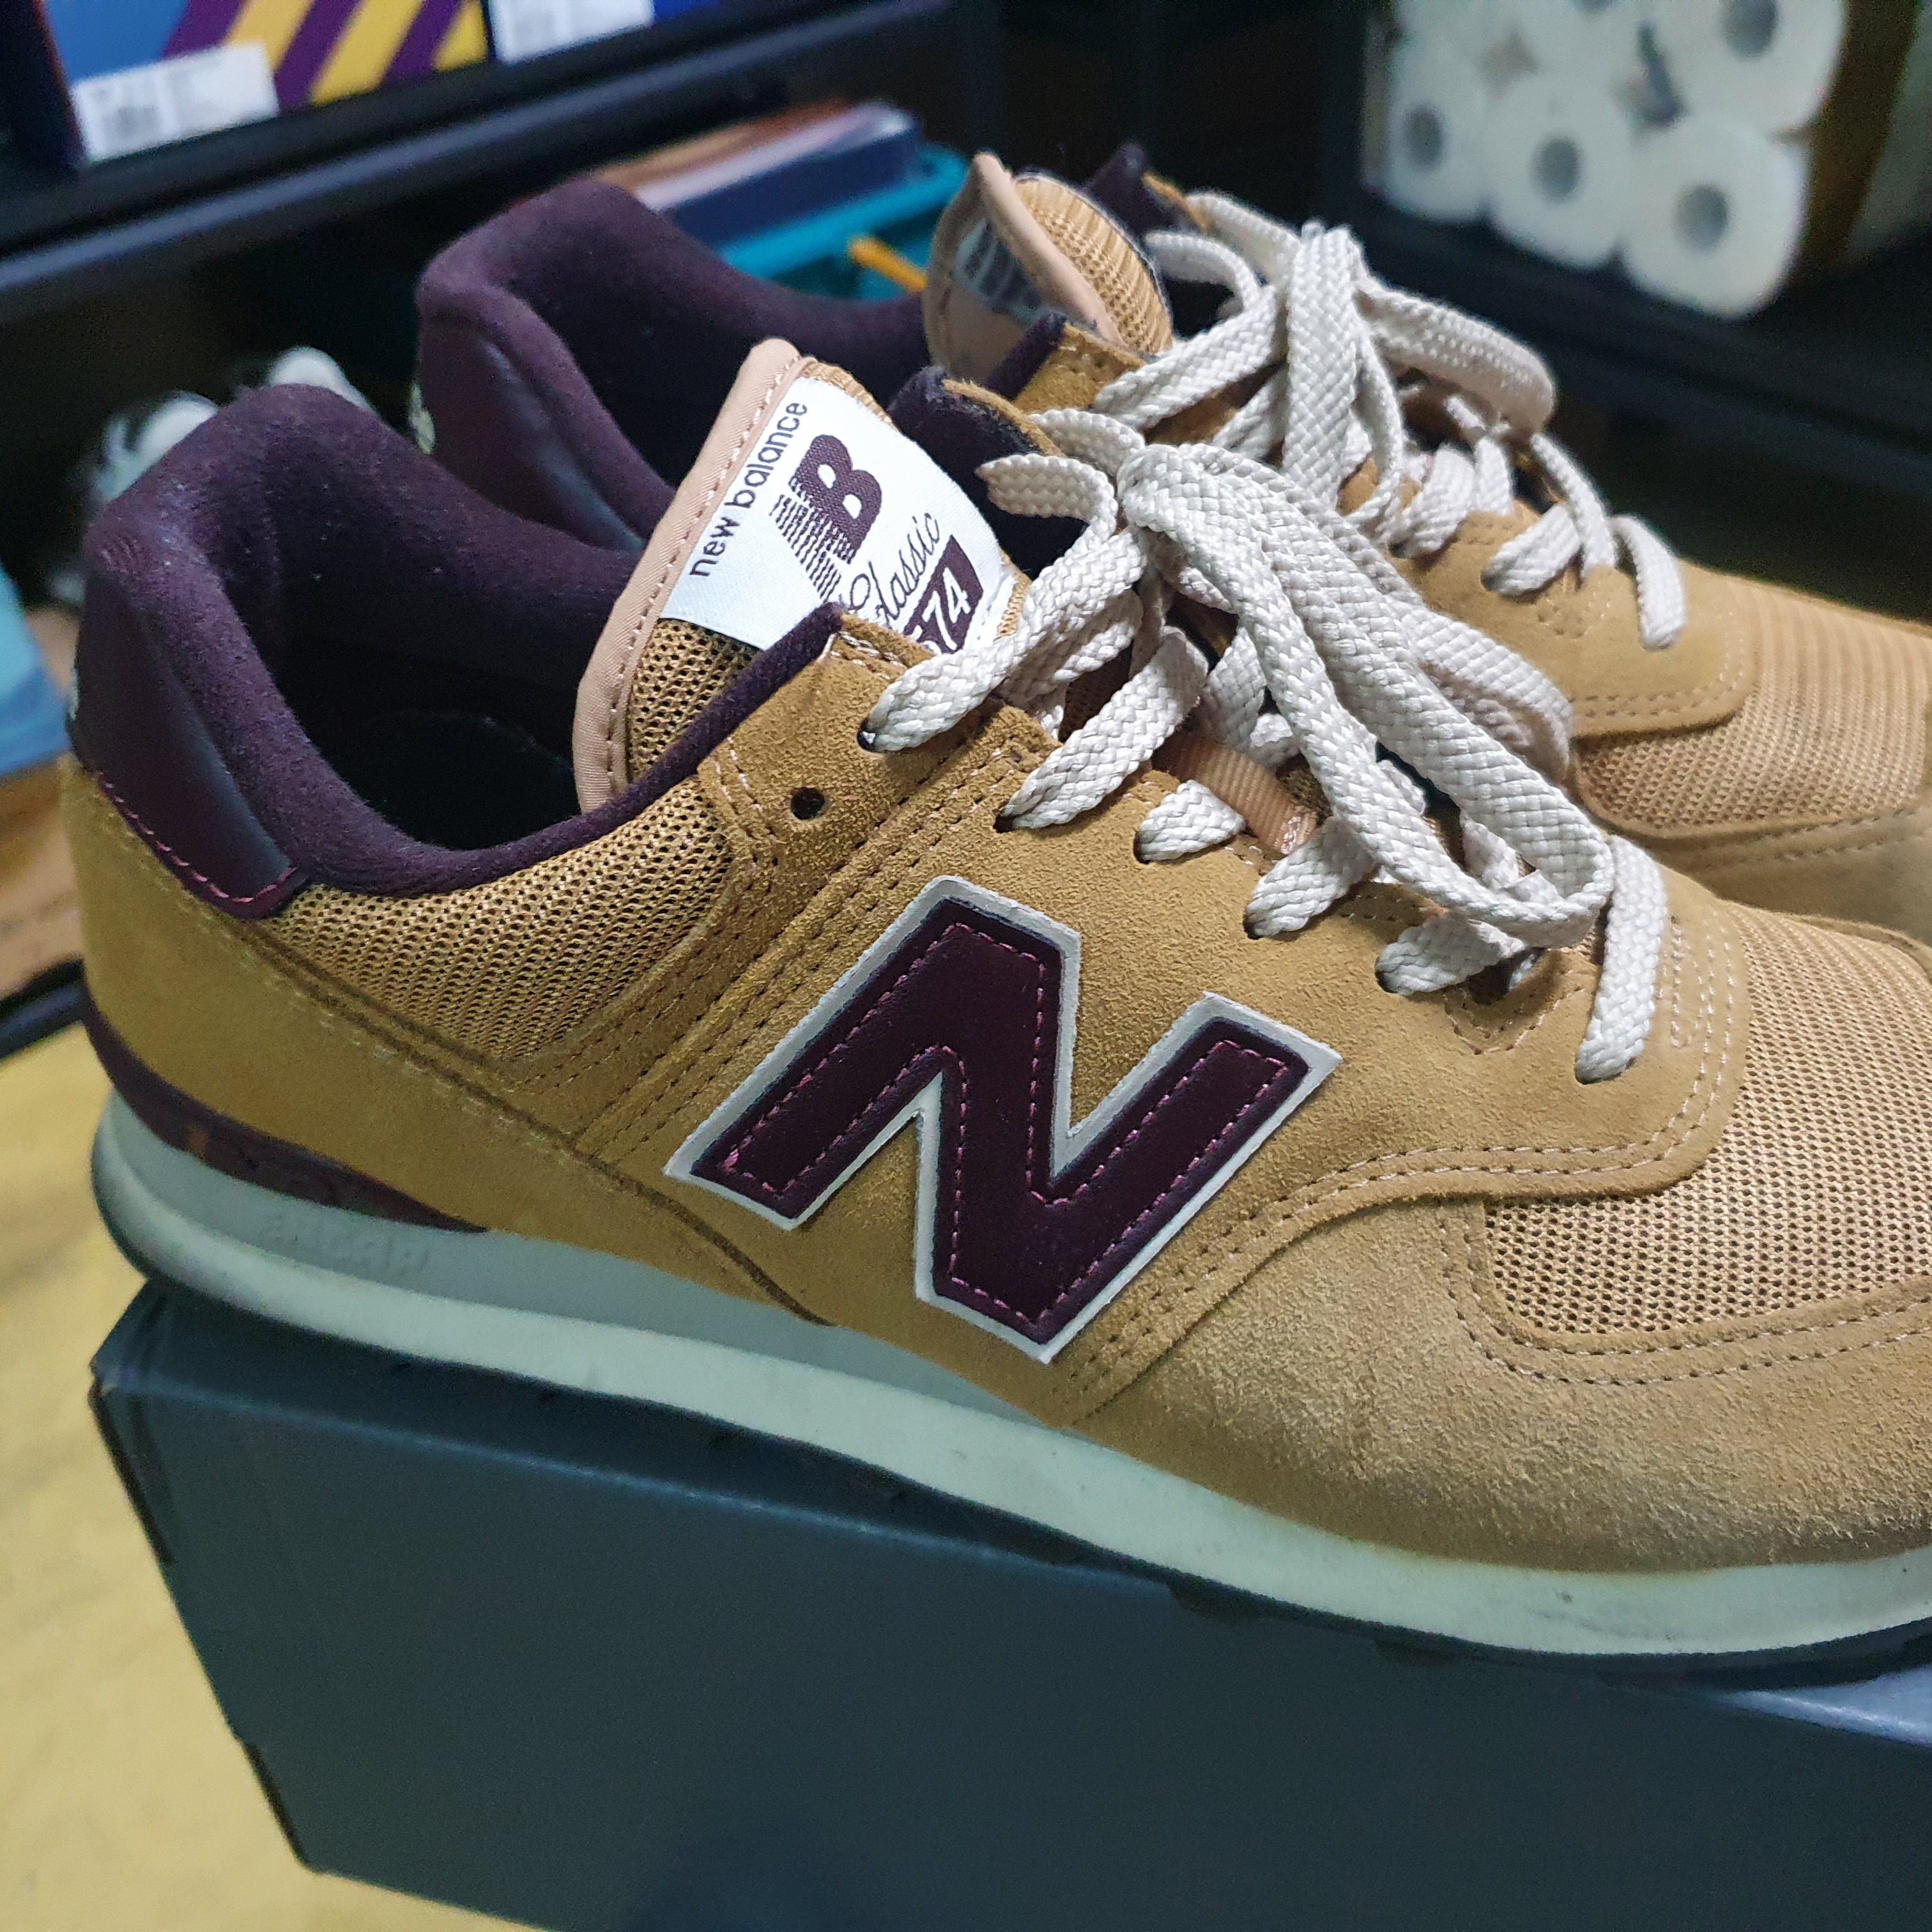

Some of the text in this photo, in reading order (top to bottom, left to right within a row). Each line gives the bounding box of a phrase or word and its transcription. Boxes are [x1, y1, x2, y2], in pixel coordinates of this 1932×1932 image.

[689, 402, 808, 577] new balance
[843, 512, 940, 630] Classic
[664, 875, 1343, 1364] N
